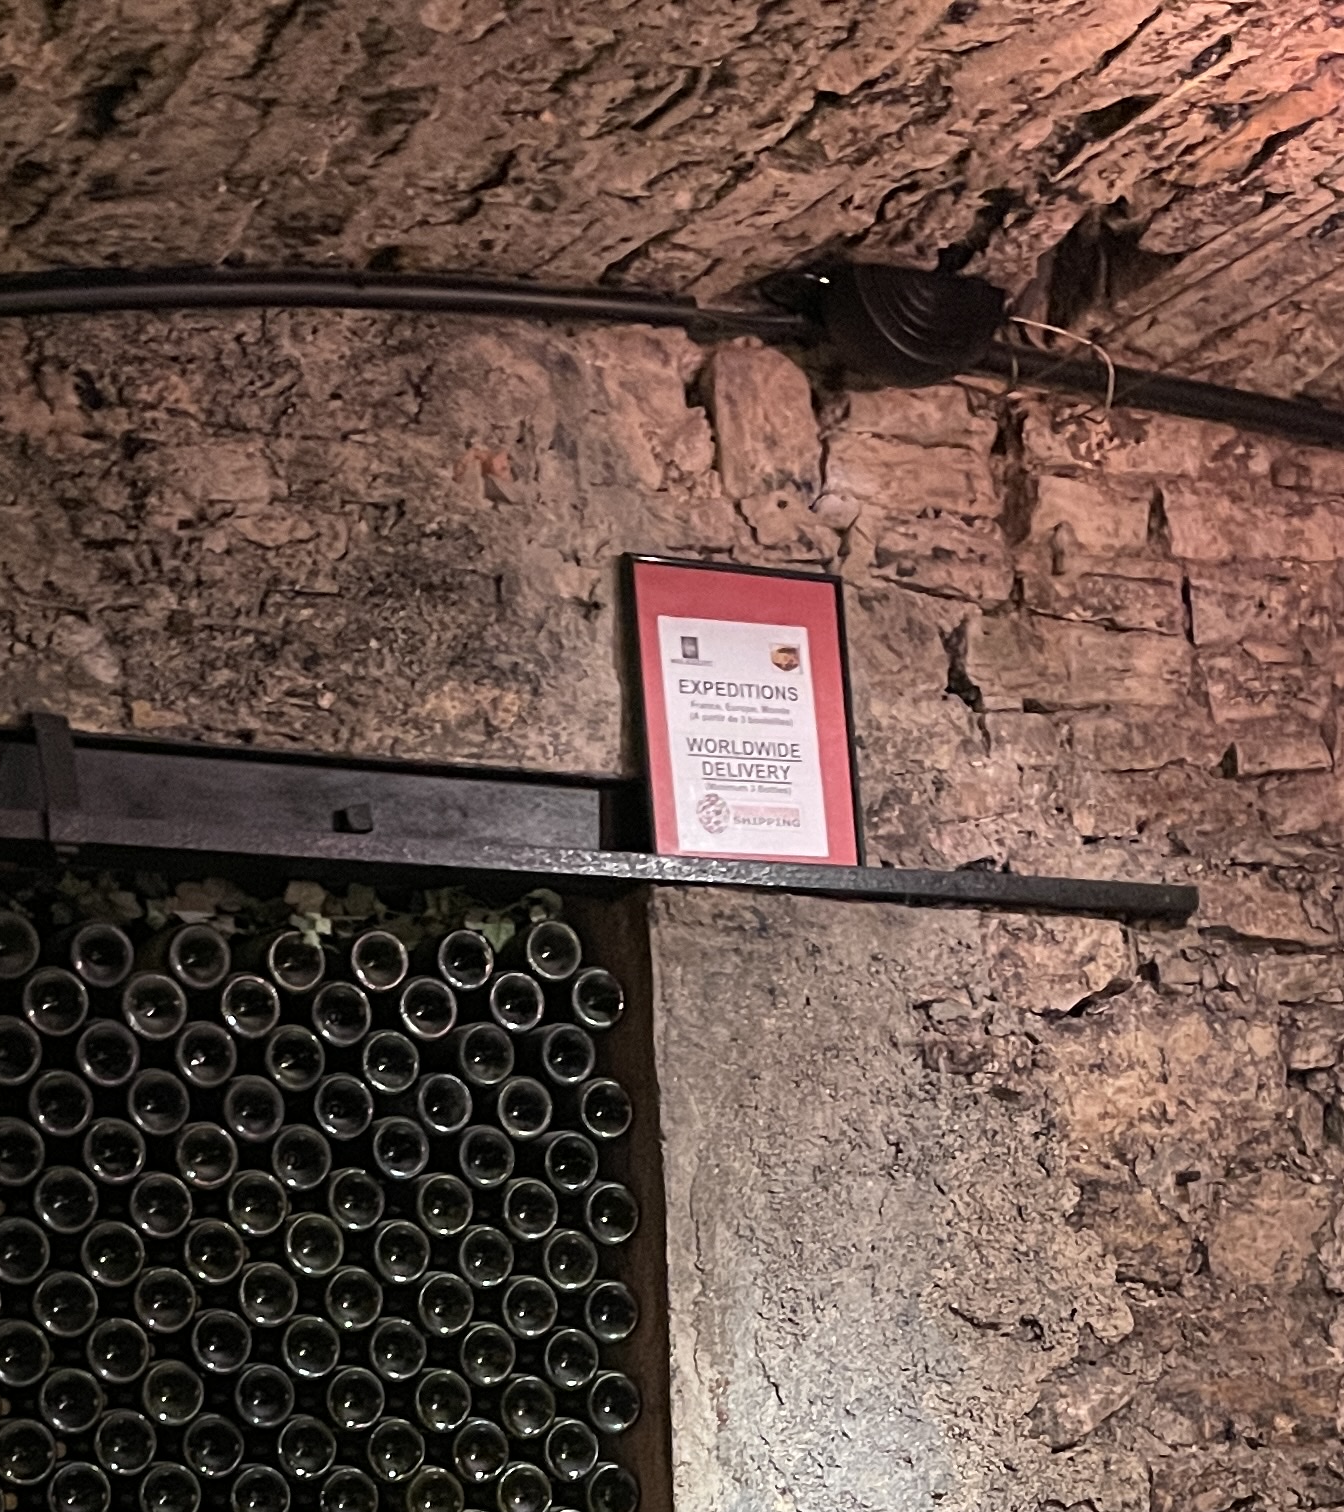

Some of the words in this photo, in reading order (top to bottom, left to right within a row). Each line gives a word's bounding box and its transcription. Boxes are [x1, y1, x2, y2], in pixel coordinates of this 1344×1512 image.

[679, 679, 798, 701] EXPEDITIONS
[686, 737, 801, 758] WORLDWIDE
[701, 761, 791, 780] DELIVERY
